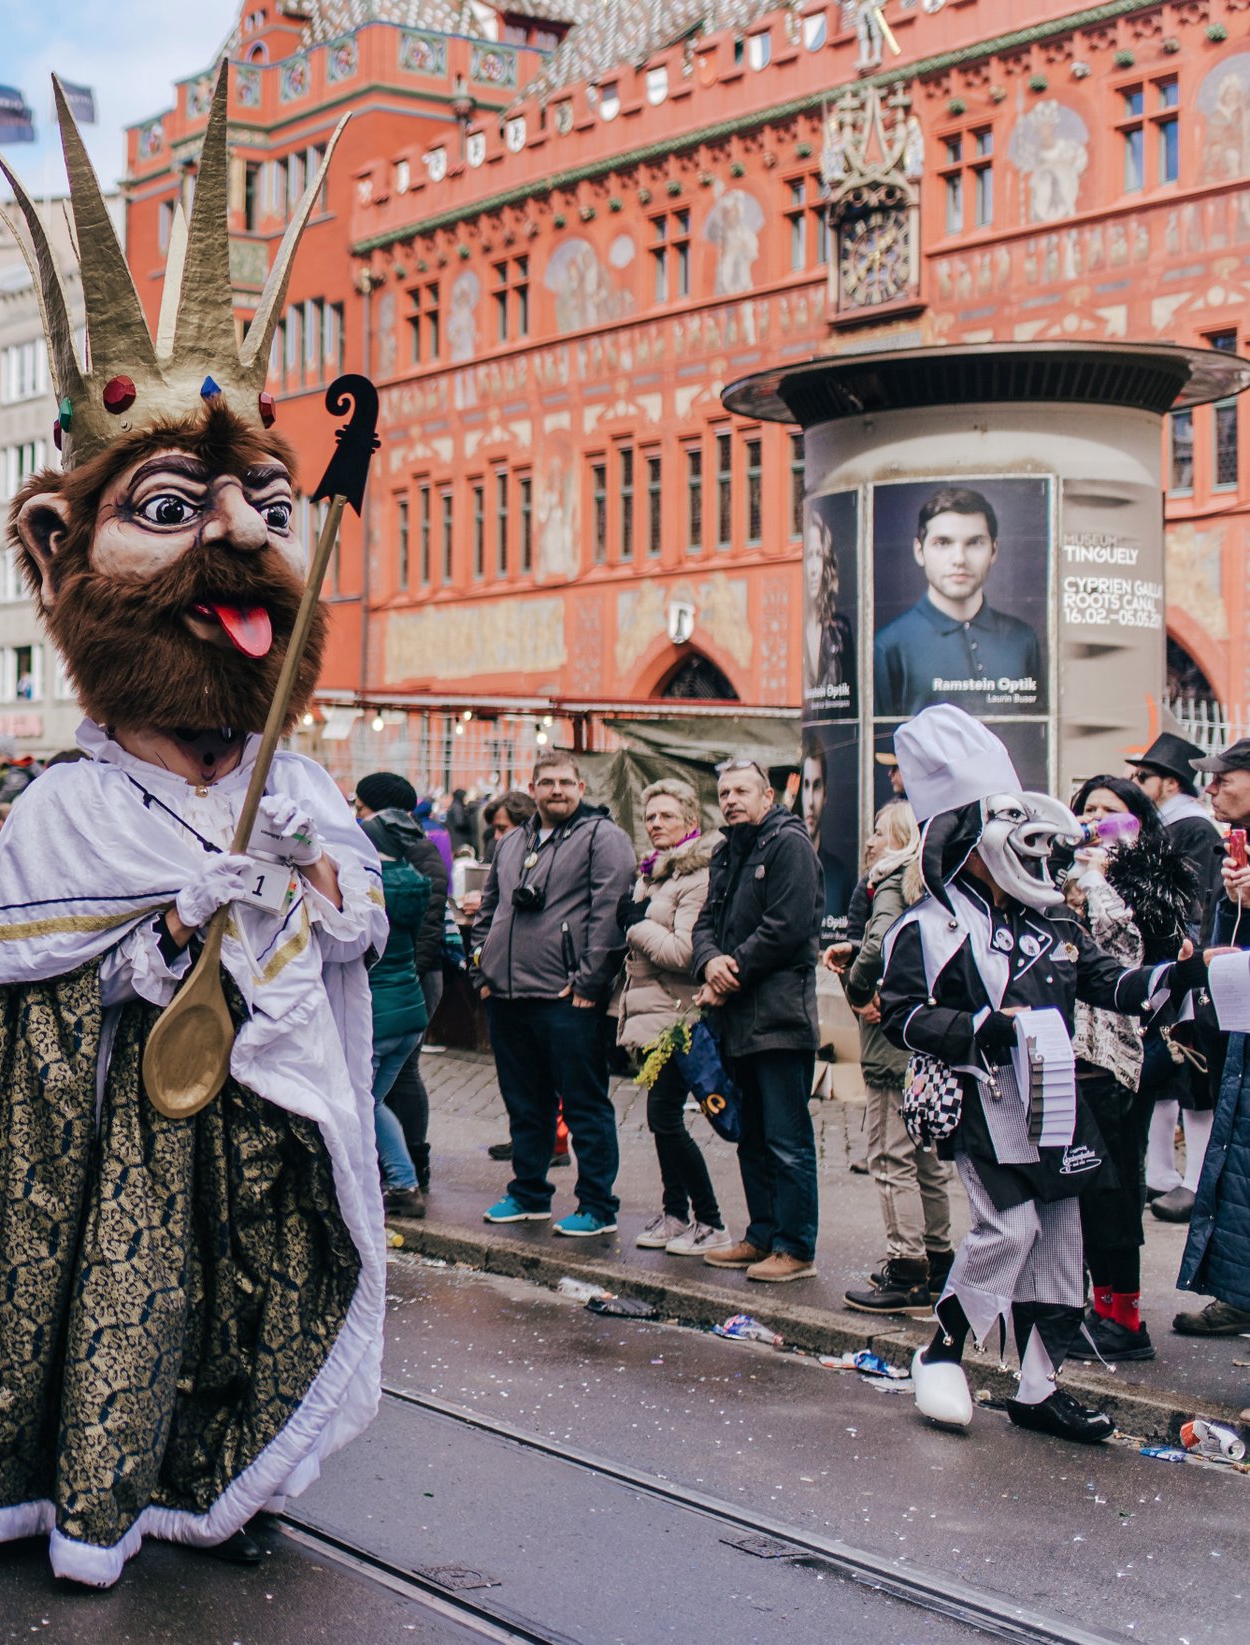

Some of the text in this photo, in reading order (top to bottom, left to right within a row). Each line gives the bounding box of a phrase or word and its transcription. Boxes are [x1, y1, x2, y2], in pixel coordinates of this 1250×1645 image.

[1063, 534, 1118, 546] MUSEUM
[1063, 545, 1139, 566] TINGUELY
[1063, 576, 1132, 594] CYPRIEN
[1063, 592, 1120, 610] ROOTS
[933, 677, 1037, 694] Ramstein Optik
[252, 875, 265, 897] 1
